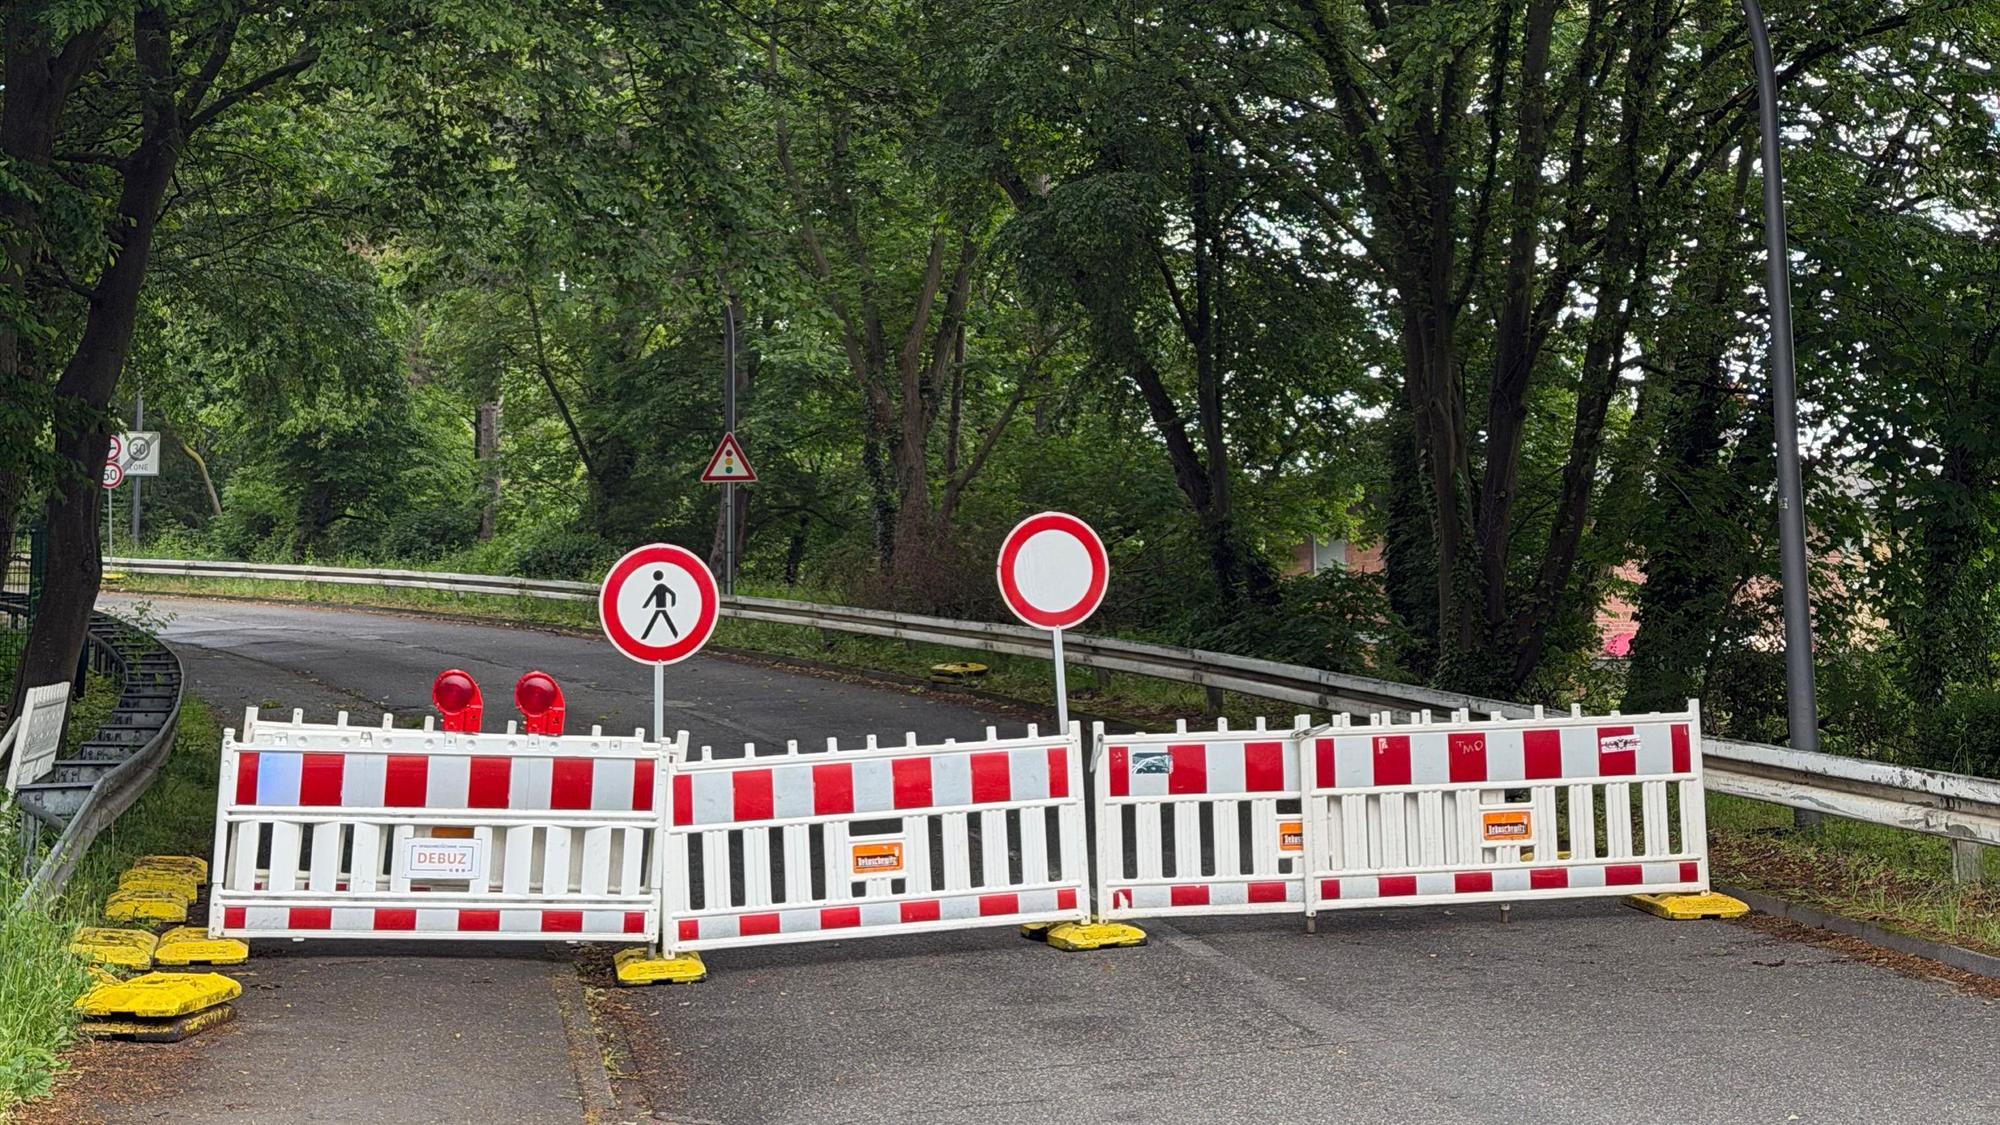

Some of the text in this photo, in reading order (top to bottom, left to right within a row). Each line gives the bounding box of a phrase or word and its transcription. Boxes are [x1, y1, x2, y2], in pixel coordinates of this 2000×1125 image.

[132, 443, 146, 455] 30
[103, 469, 117, 481] 50
[417, 852, 467, 865] DEBUZ
